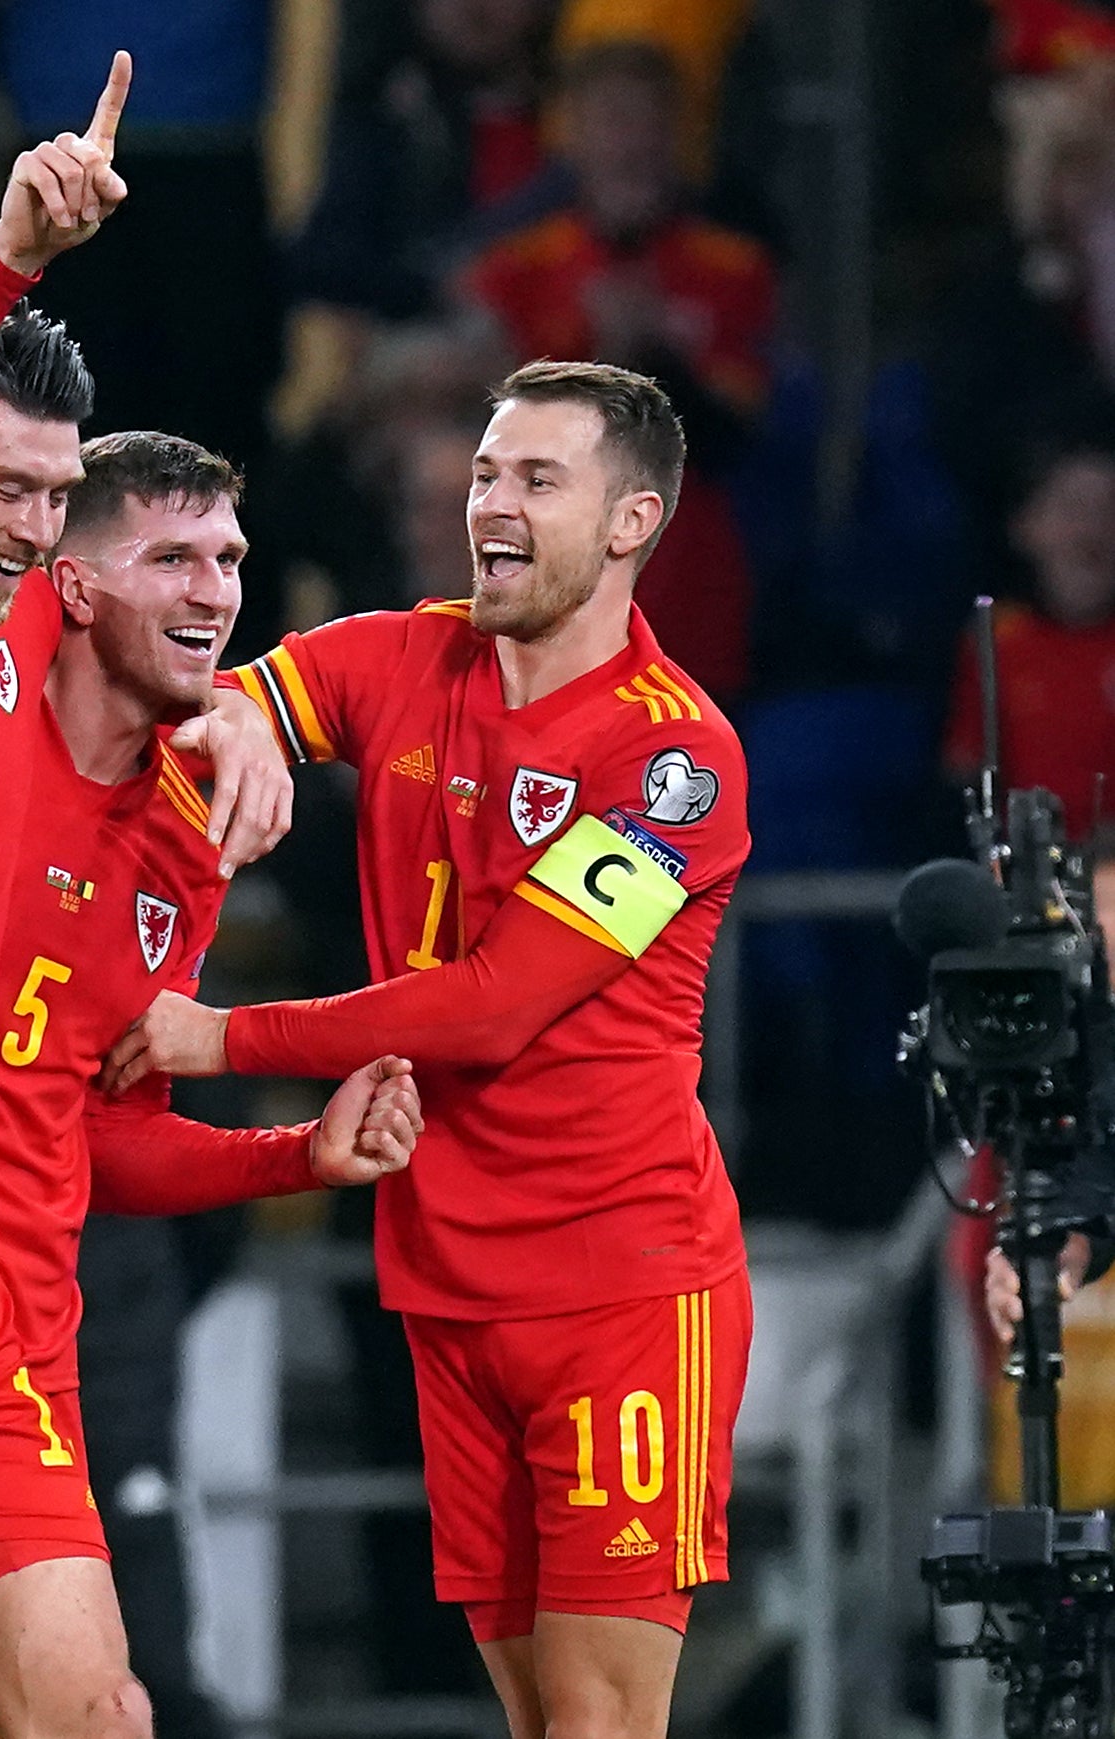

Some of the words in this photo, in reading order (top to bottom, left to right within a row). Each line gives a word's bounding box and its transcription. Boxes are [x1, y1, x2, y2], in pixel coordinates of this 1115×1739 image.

[390, 761, 437, 785] adidas
[406, 859, 466, 971] 1
[583, 853, 638, 907] C
[1, 955, 73, 1067] 5
[13, 1366, 76, 1467] 1
[568, 1389, 665, 1507] 10
[604, 1540, 660, 1558] adidas
